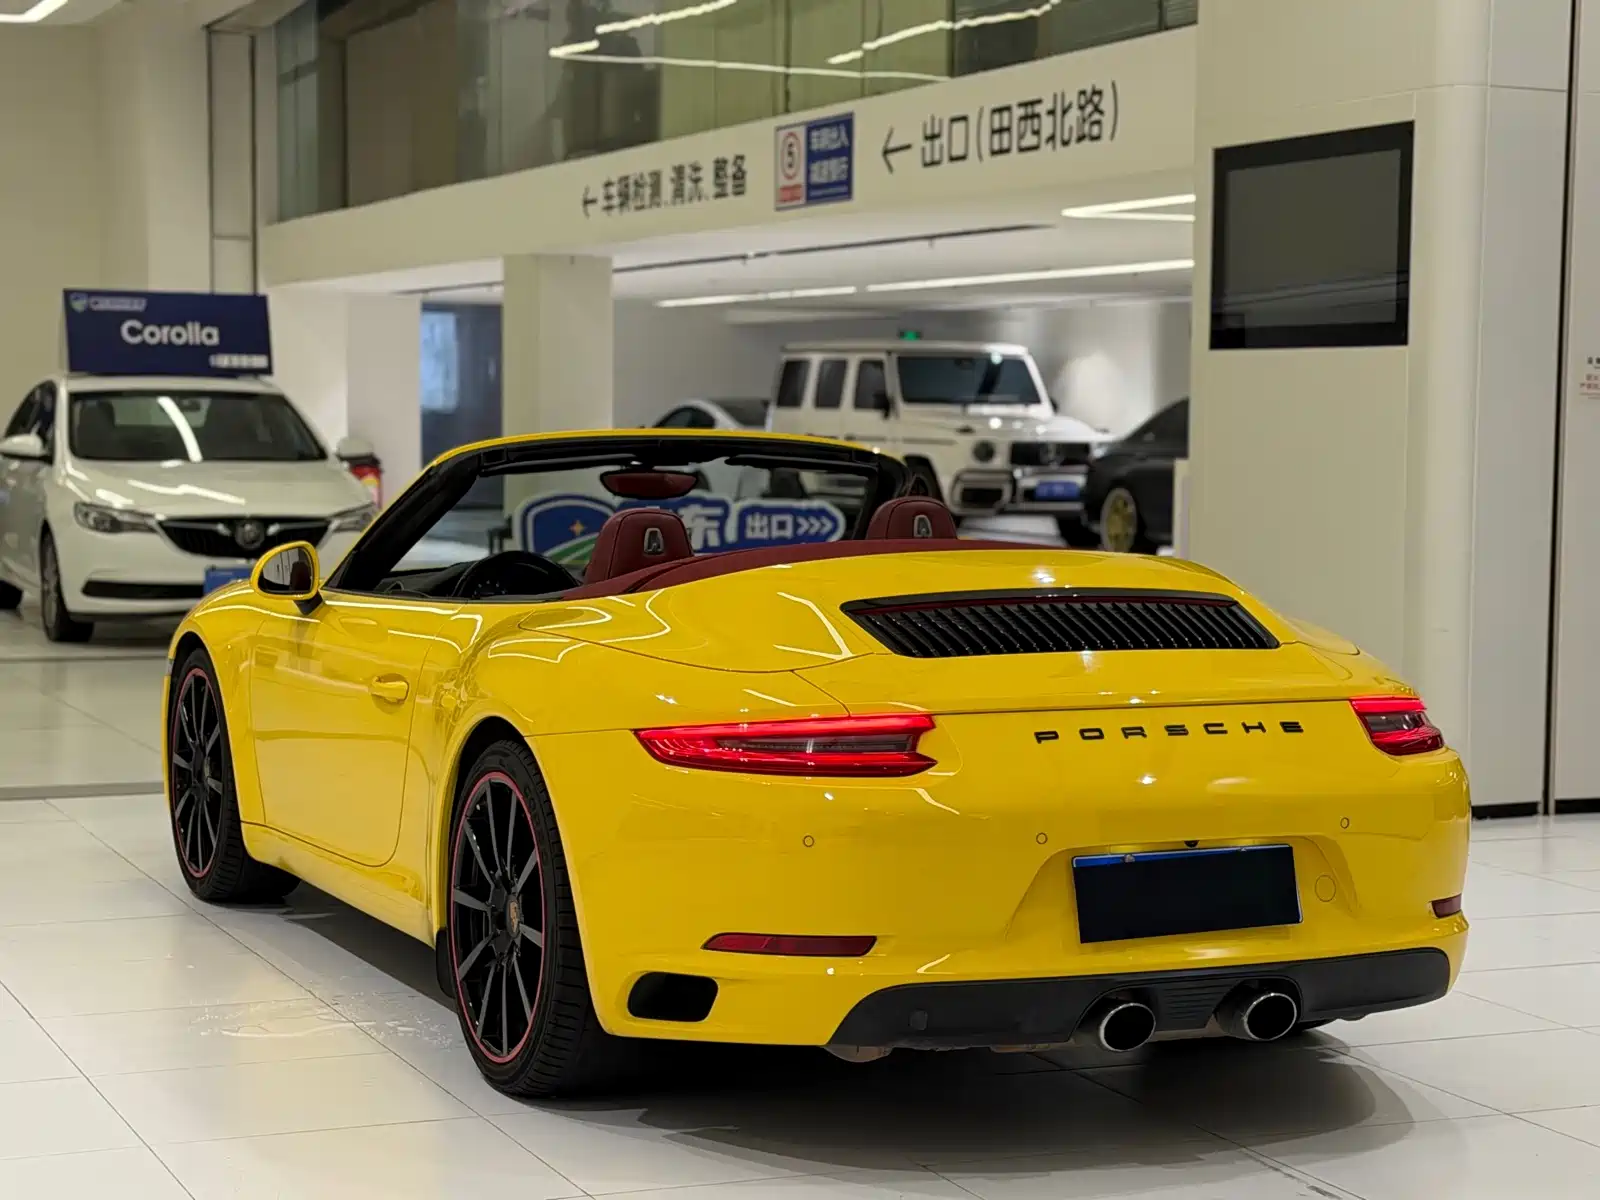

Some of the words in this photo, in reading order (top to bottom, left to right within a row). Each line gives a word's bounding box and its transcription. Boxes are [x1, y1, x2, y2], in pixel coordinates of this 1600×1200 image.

[120, 319, 220, 346] Corolla
[745, 512, 793, 540] 出口
[1034, 721, 1304, 744] PORSCHE
